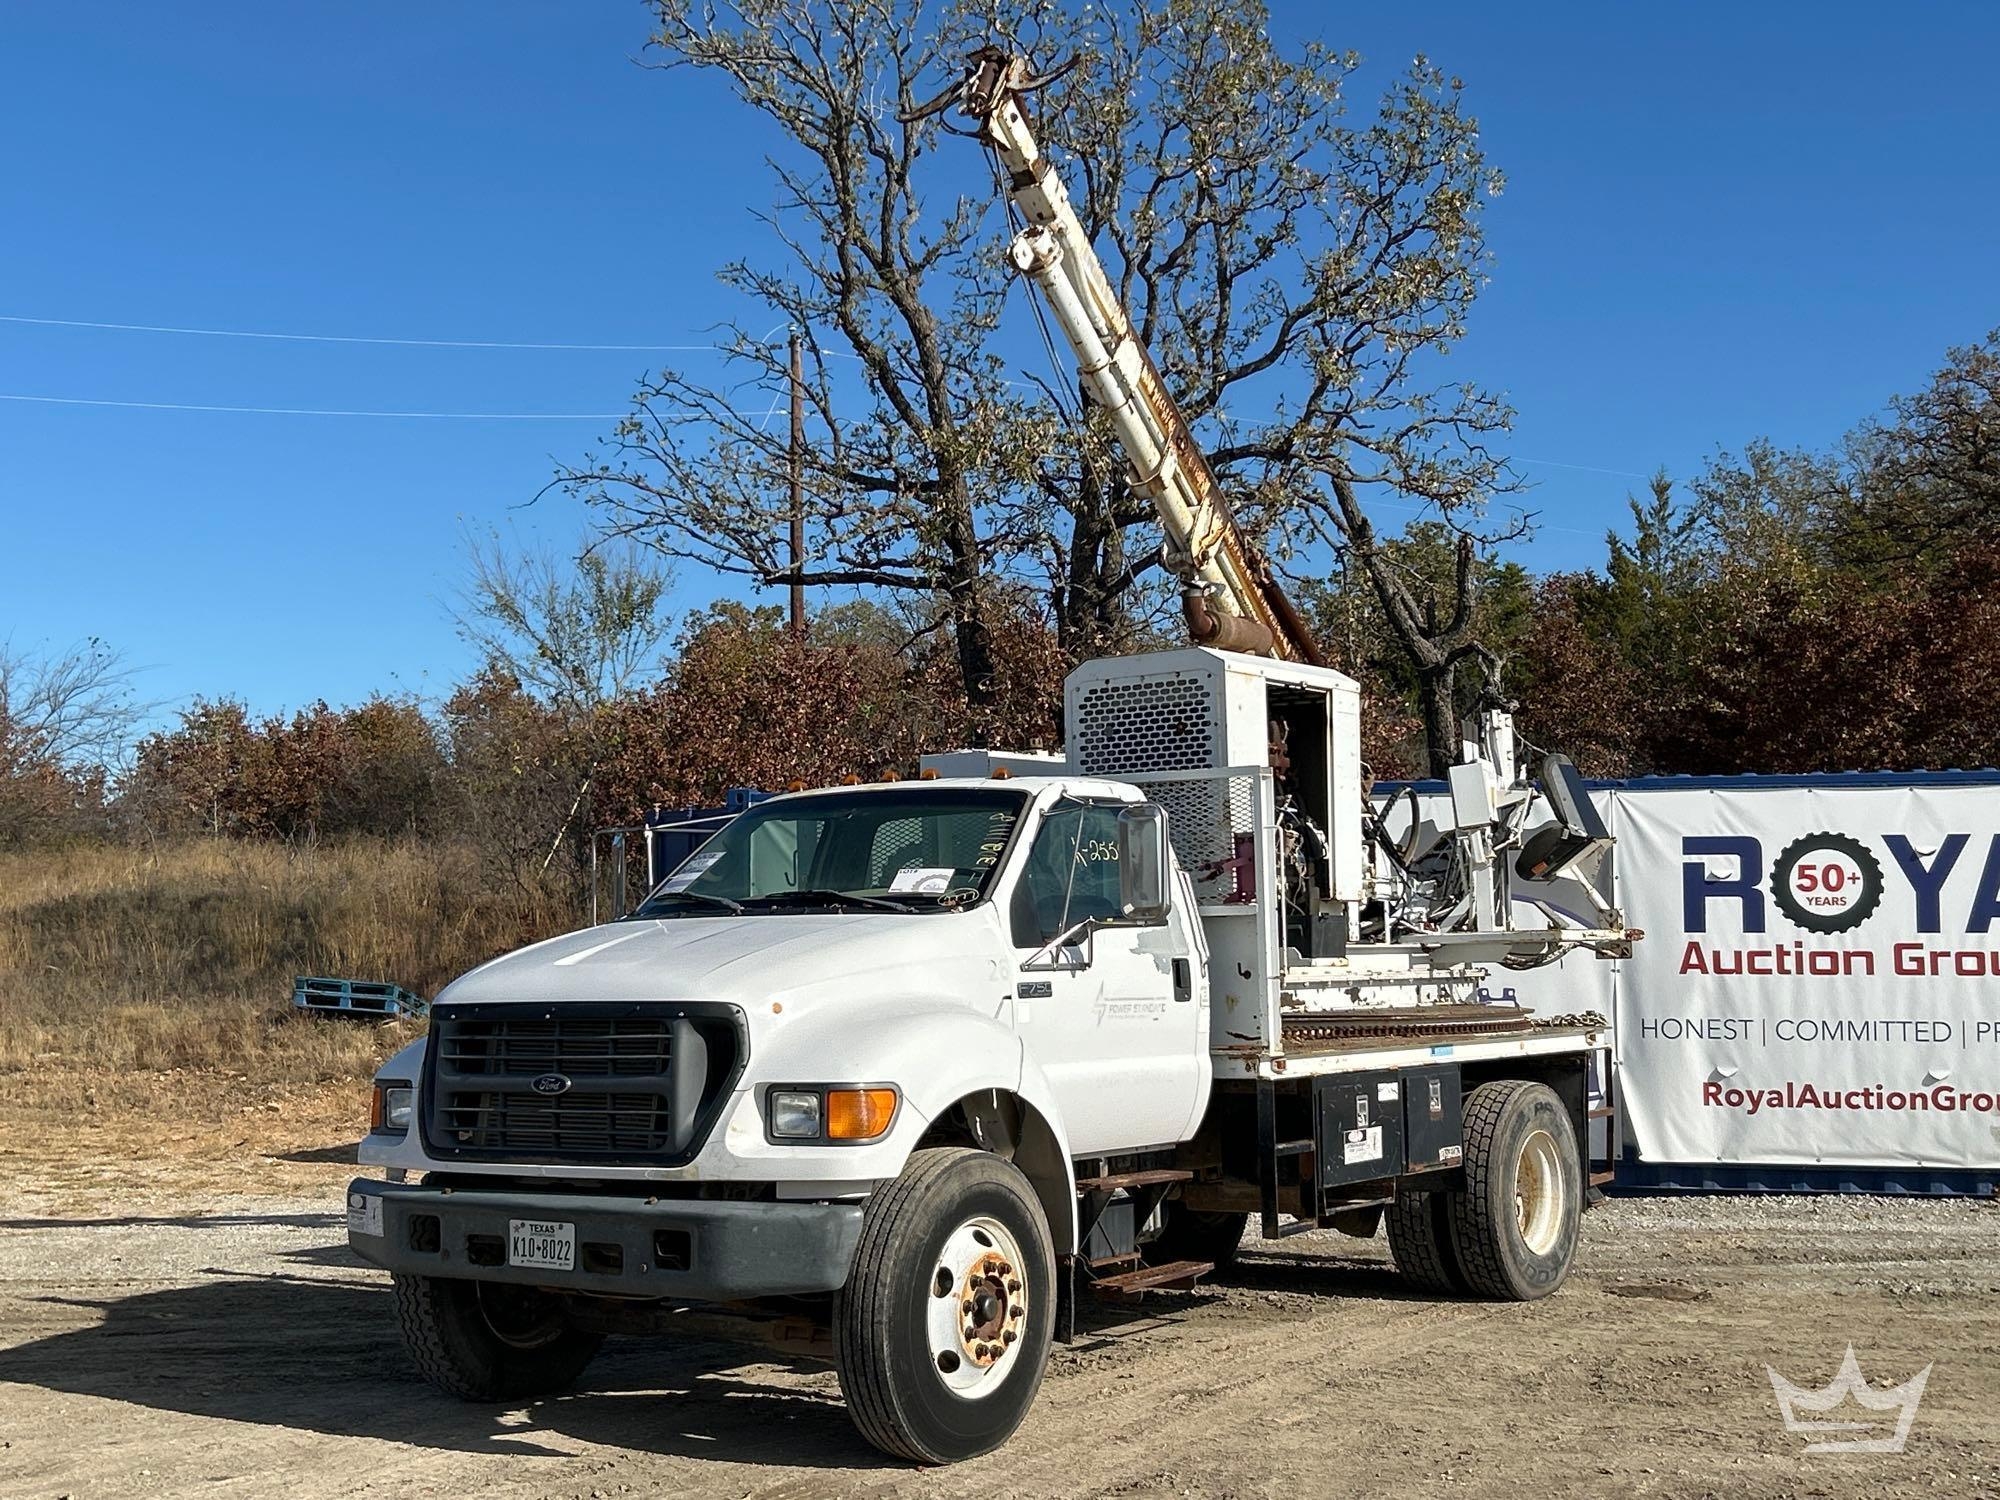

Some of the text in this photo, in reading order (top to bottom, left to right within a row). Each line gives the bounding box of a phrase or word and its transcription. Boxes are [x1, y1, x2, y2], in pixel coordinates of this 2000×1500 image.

[1796, 864, 1860, 892] 50+
[1806, 896, 1847, 906] YEARS
[1679, 940, 1875, 976] Auction
[1641, 1018, 1754, 1040] HONEST
[1775, 1019, 1952, 1042] COMMITTED
[539, 1077, 561, 1090] Ford
[529, 1224, 555, 1233] TEXAS
